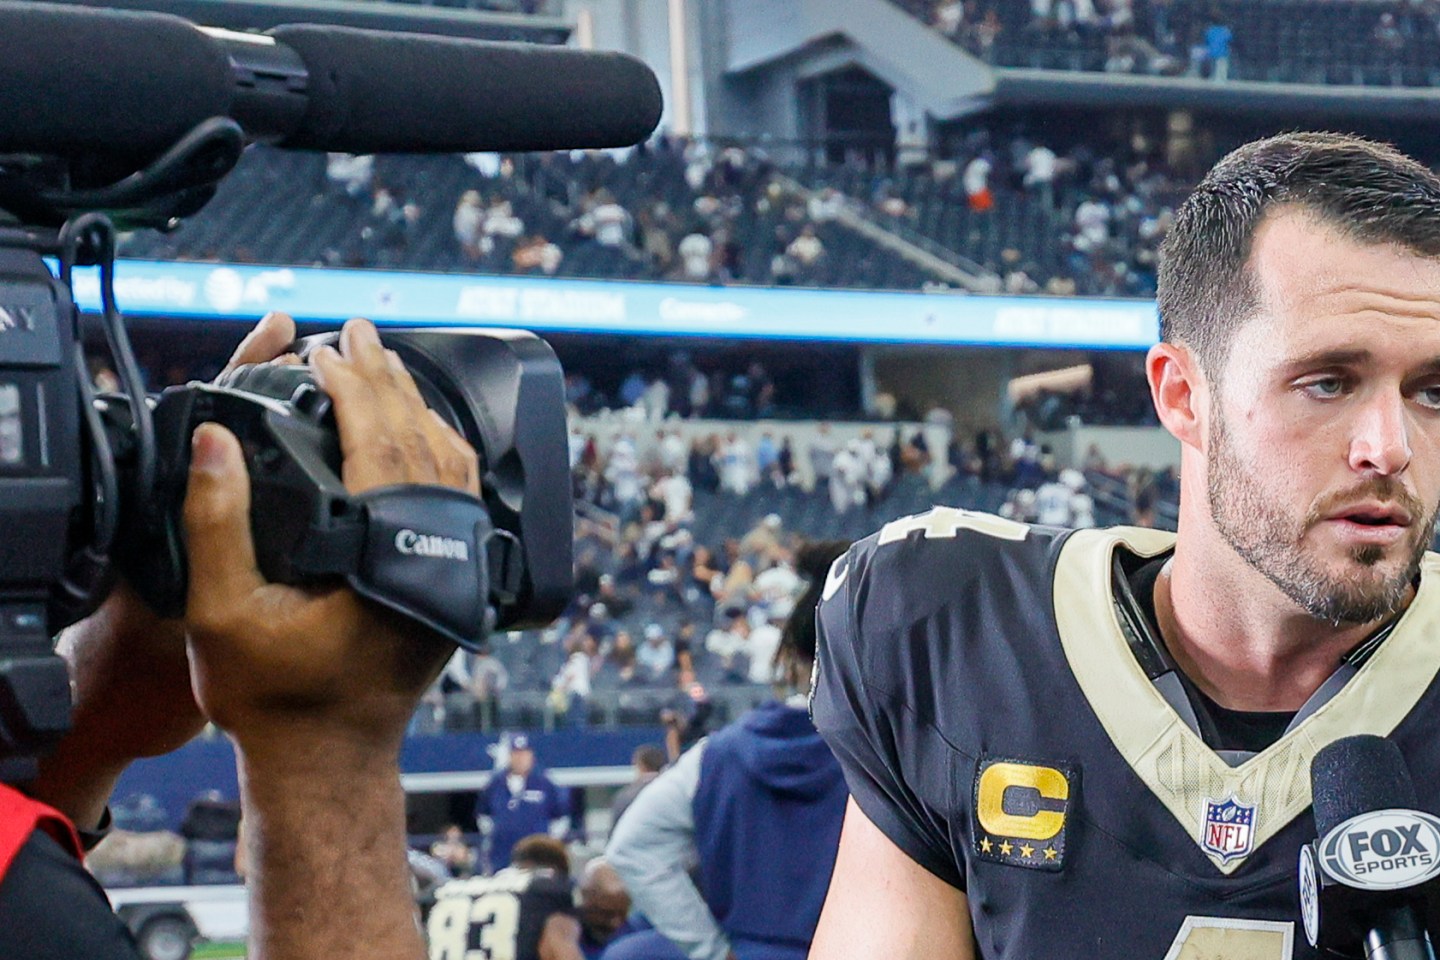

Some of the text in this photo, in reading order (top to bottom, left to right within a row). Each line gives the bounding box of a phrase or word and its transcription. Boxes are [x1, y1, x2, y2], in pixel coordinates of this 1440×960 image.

[395, 528, 469, 562] Canon
[977, 762, 1069, 840] C
[1208, 822, 1246, 851] NFL
[1347, 823, 1429, 862] FOX
[1353, 853, 1433, 874] SPORTS
